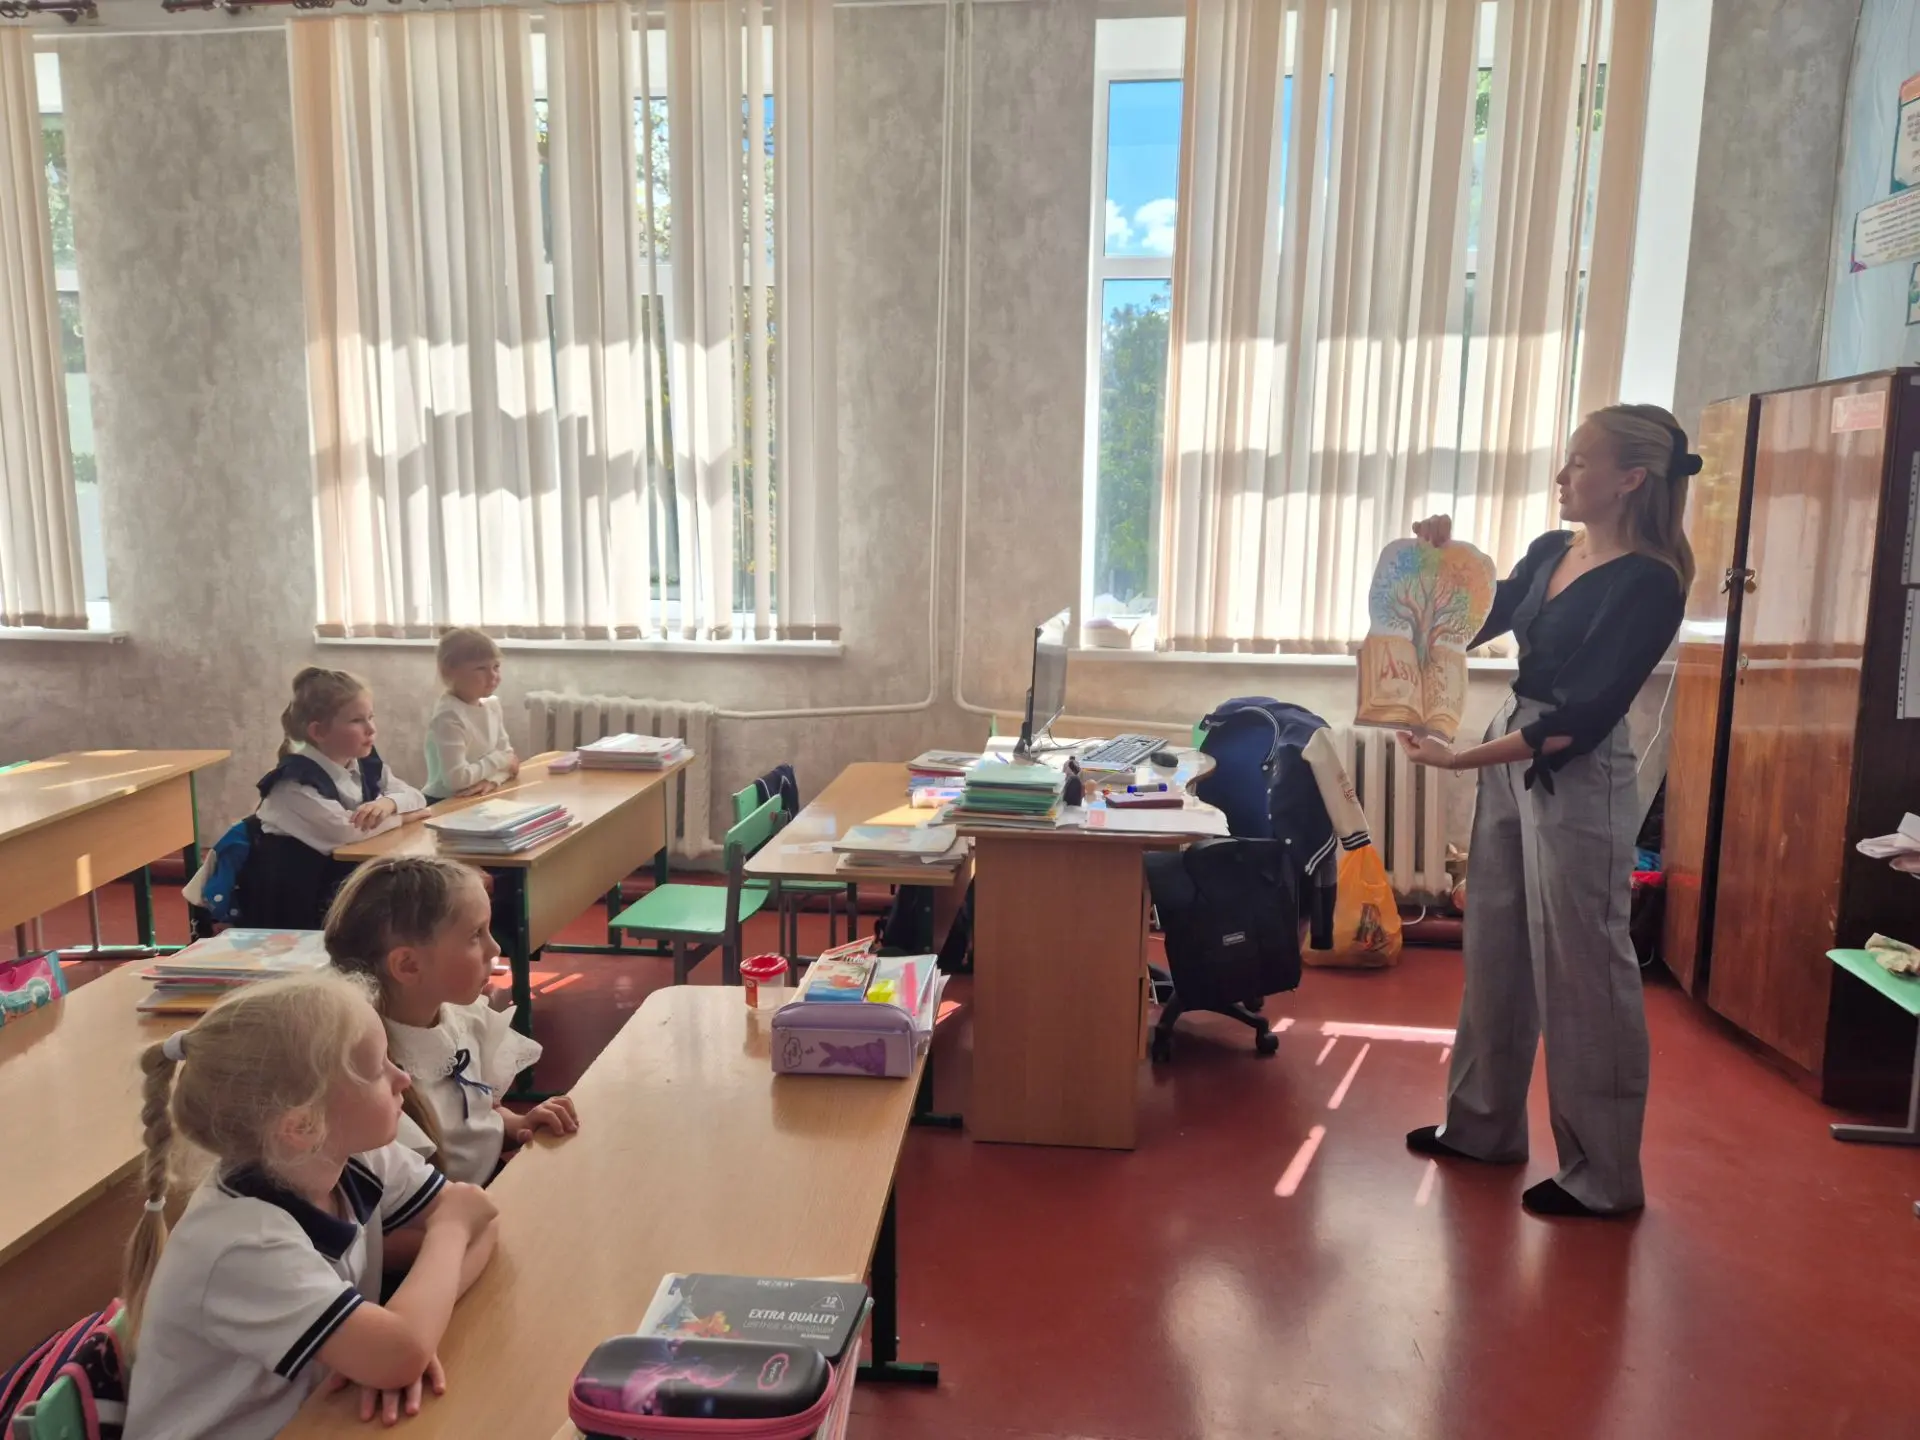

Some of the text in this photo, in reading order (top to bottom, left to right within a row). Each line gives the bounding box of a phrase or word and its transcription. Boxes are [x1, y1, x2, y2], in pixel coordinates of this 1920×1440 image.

[825, 1296, 838, 1305] 12
[748, 1308, 839, 1325] EXTRA QUALITY
